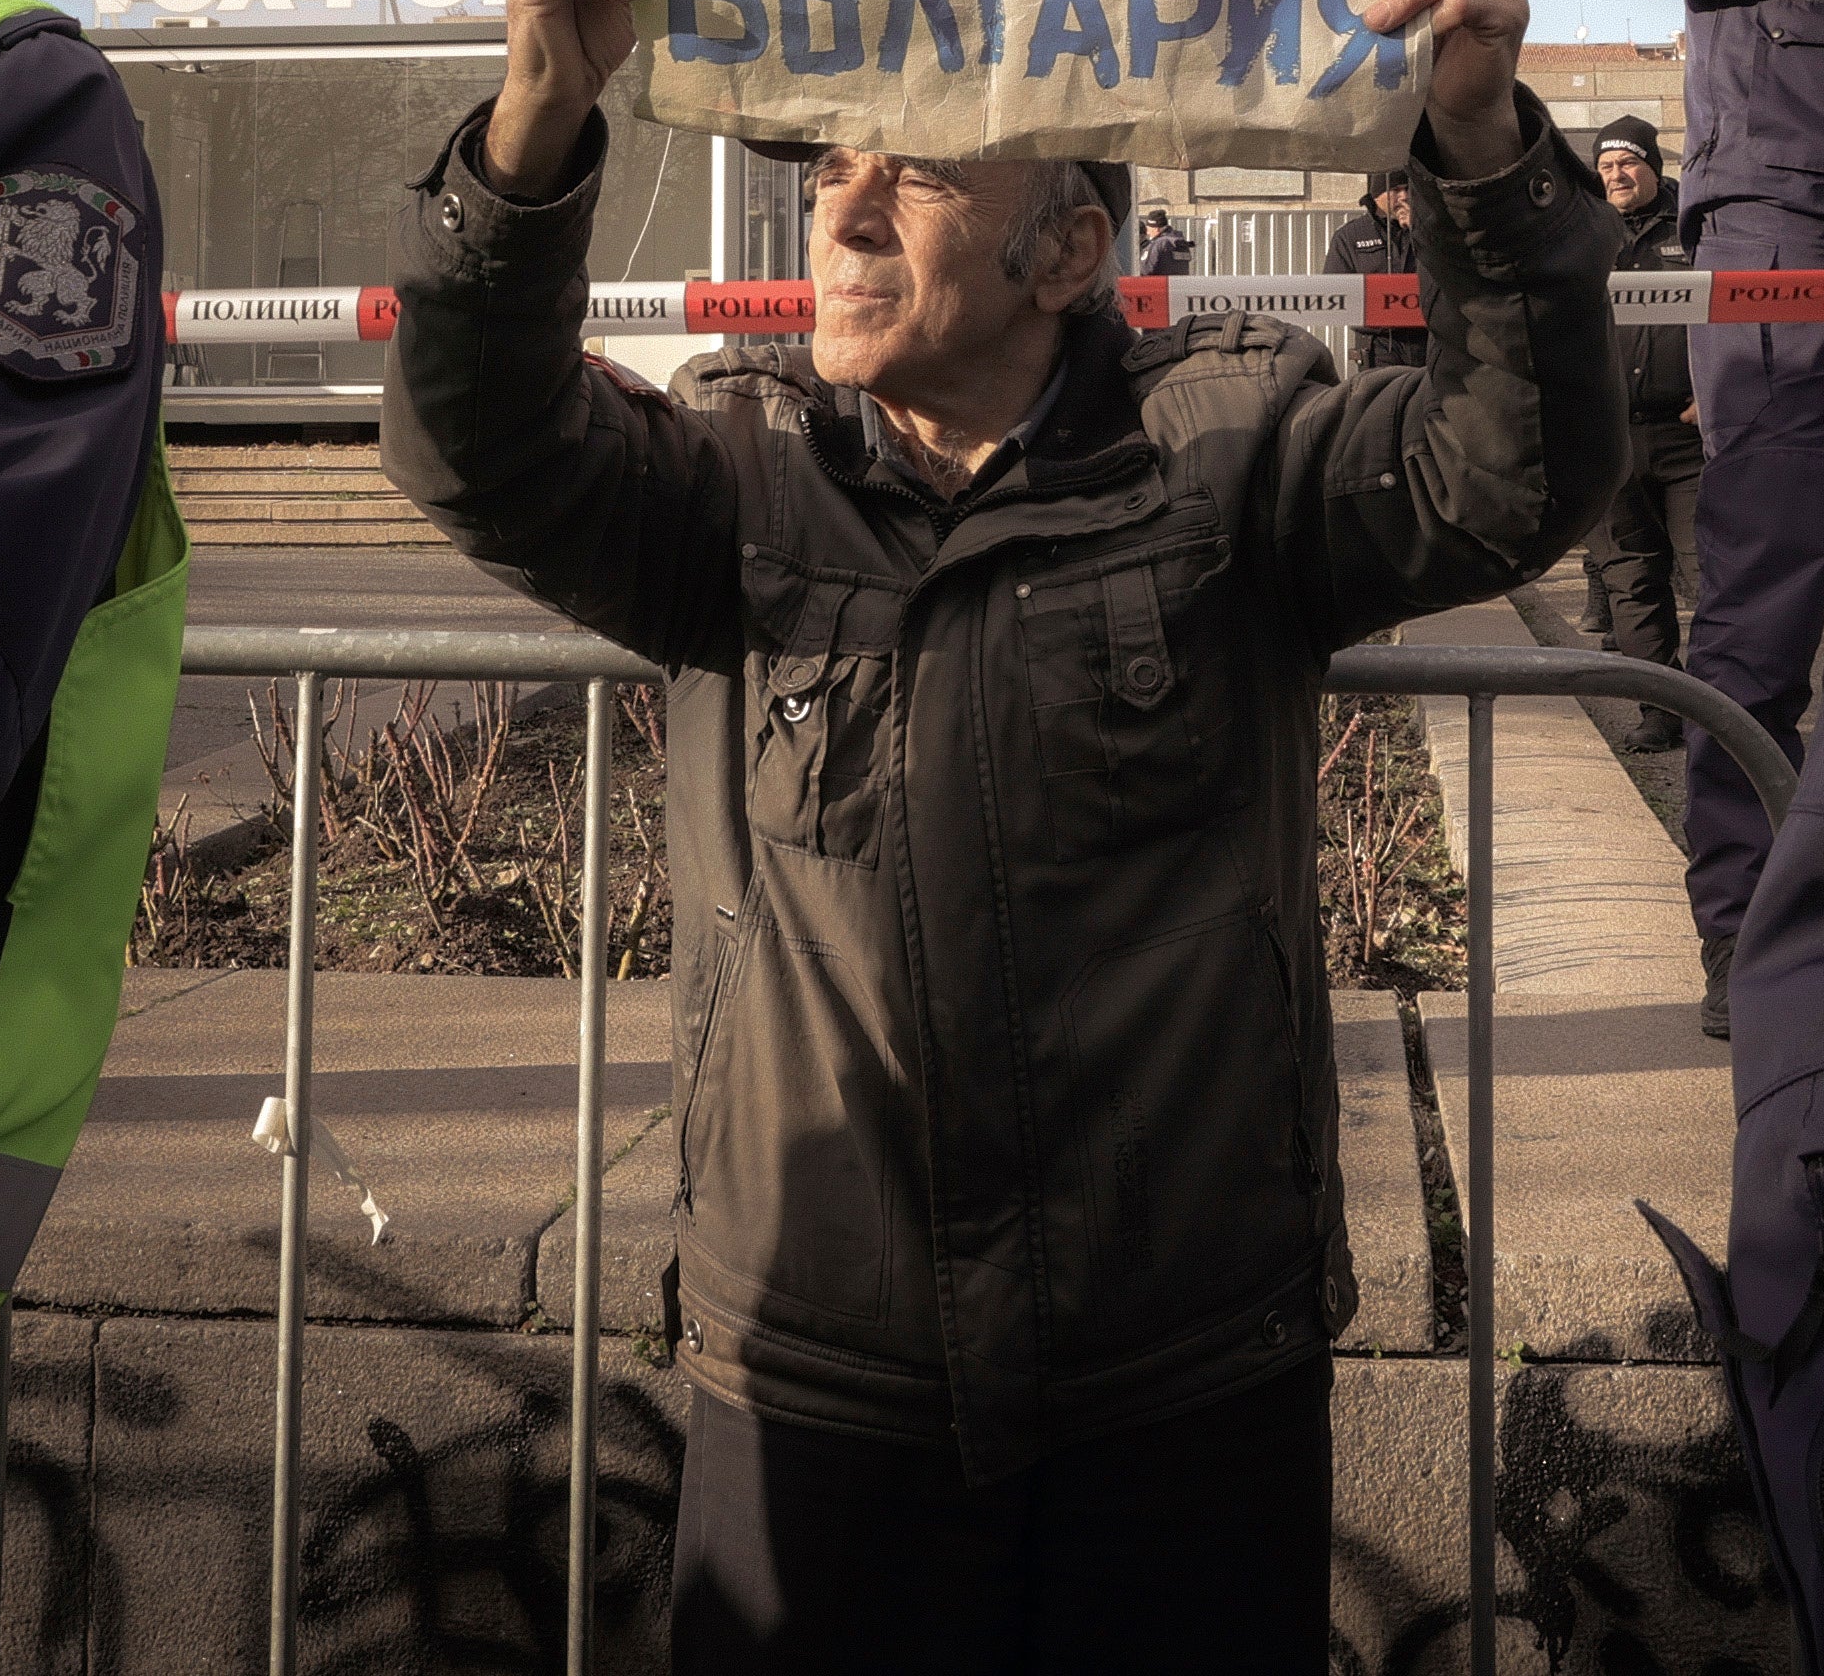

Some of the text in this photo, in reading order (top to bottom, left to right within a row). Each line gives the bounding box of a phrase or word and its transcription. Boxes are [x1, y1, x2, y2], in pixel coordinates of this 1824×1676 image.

[191, 299, 341, 325] ПОЛИЦИЯ
[702, 296, 815, 319] POLICE
[1186, 294, 1348, 314] ПОЛИЦИЯ
